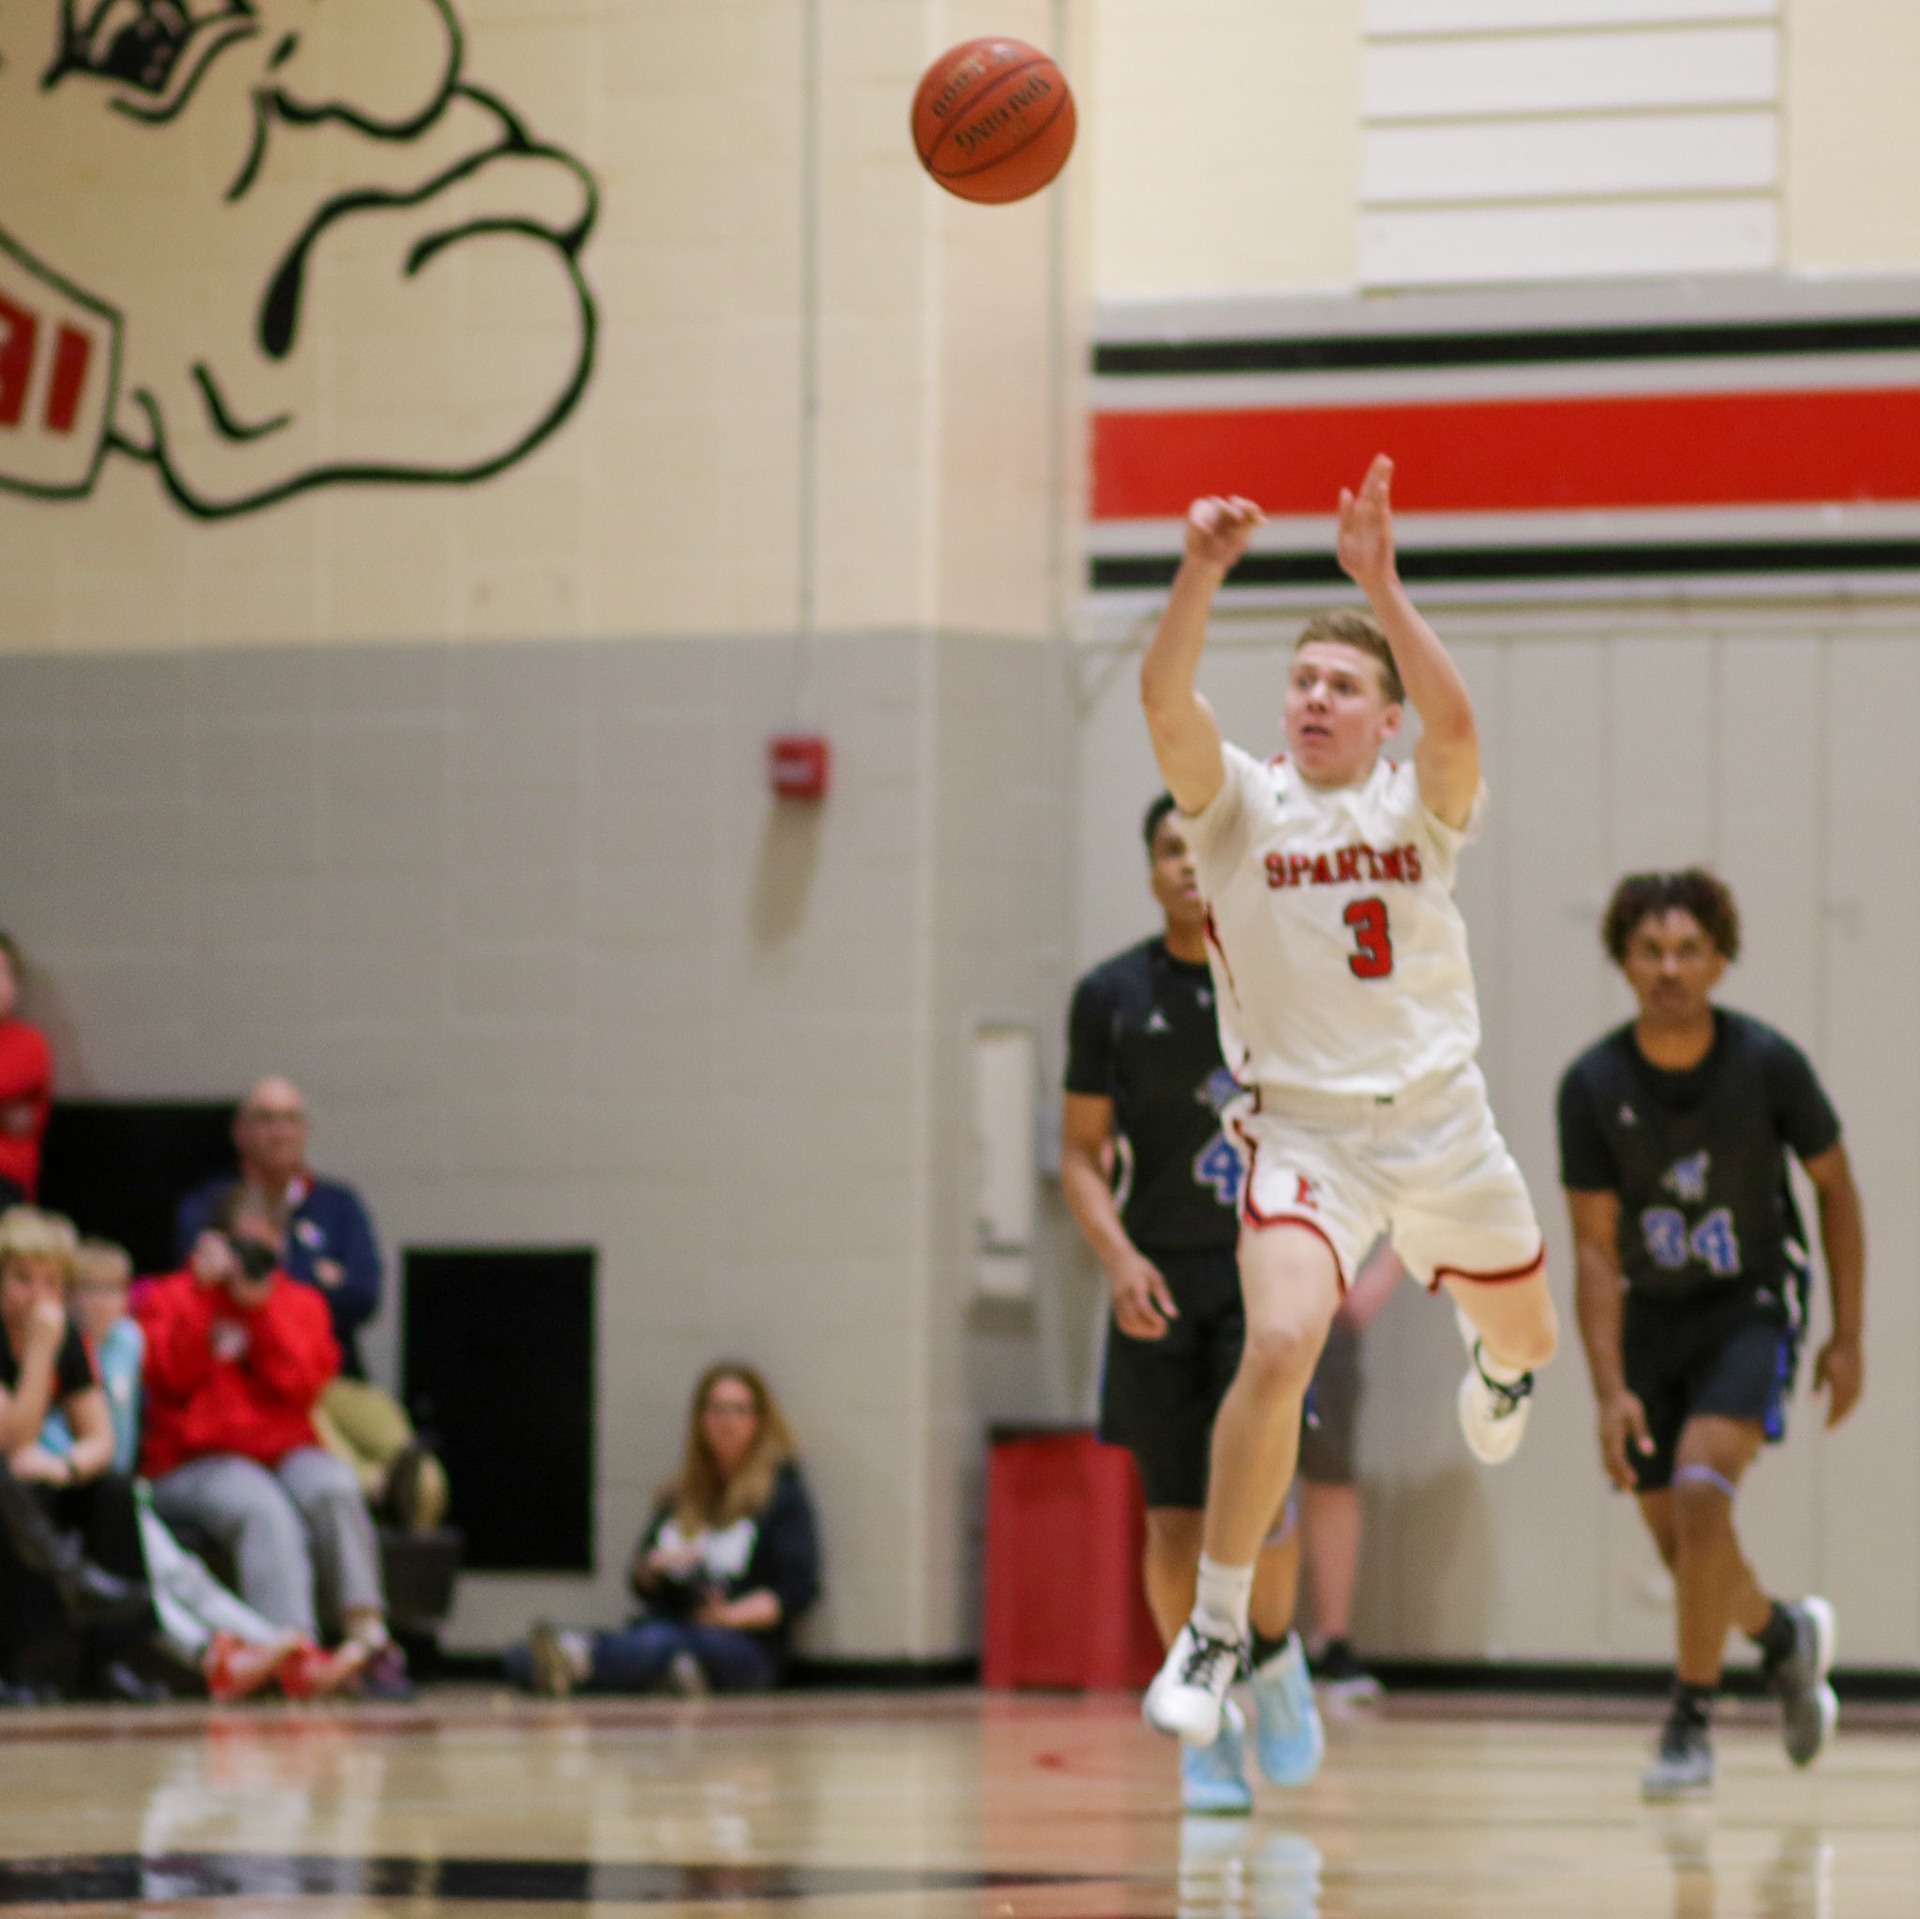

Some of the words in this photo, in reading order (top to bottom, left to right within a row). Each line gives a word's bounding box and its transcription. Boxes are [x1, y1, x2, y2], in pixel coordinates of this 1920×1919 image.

[954, 74, 1051, 156] SPALDING
[1265, 841, 1421, 888] SPARTNS
[1343, 896, 1393, 978] 3
[1641, 1206, 1741, 1273] 34
